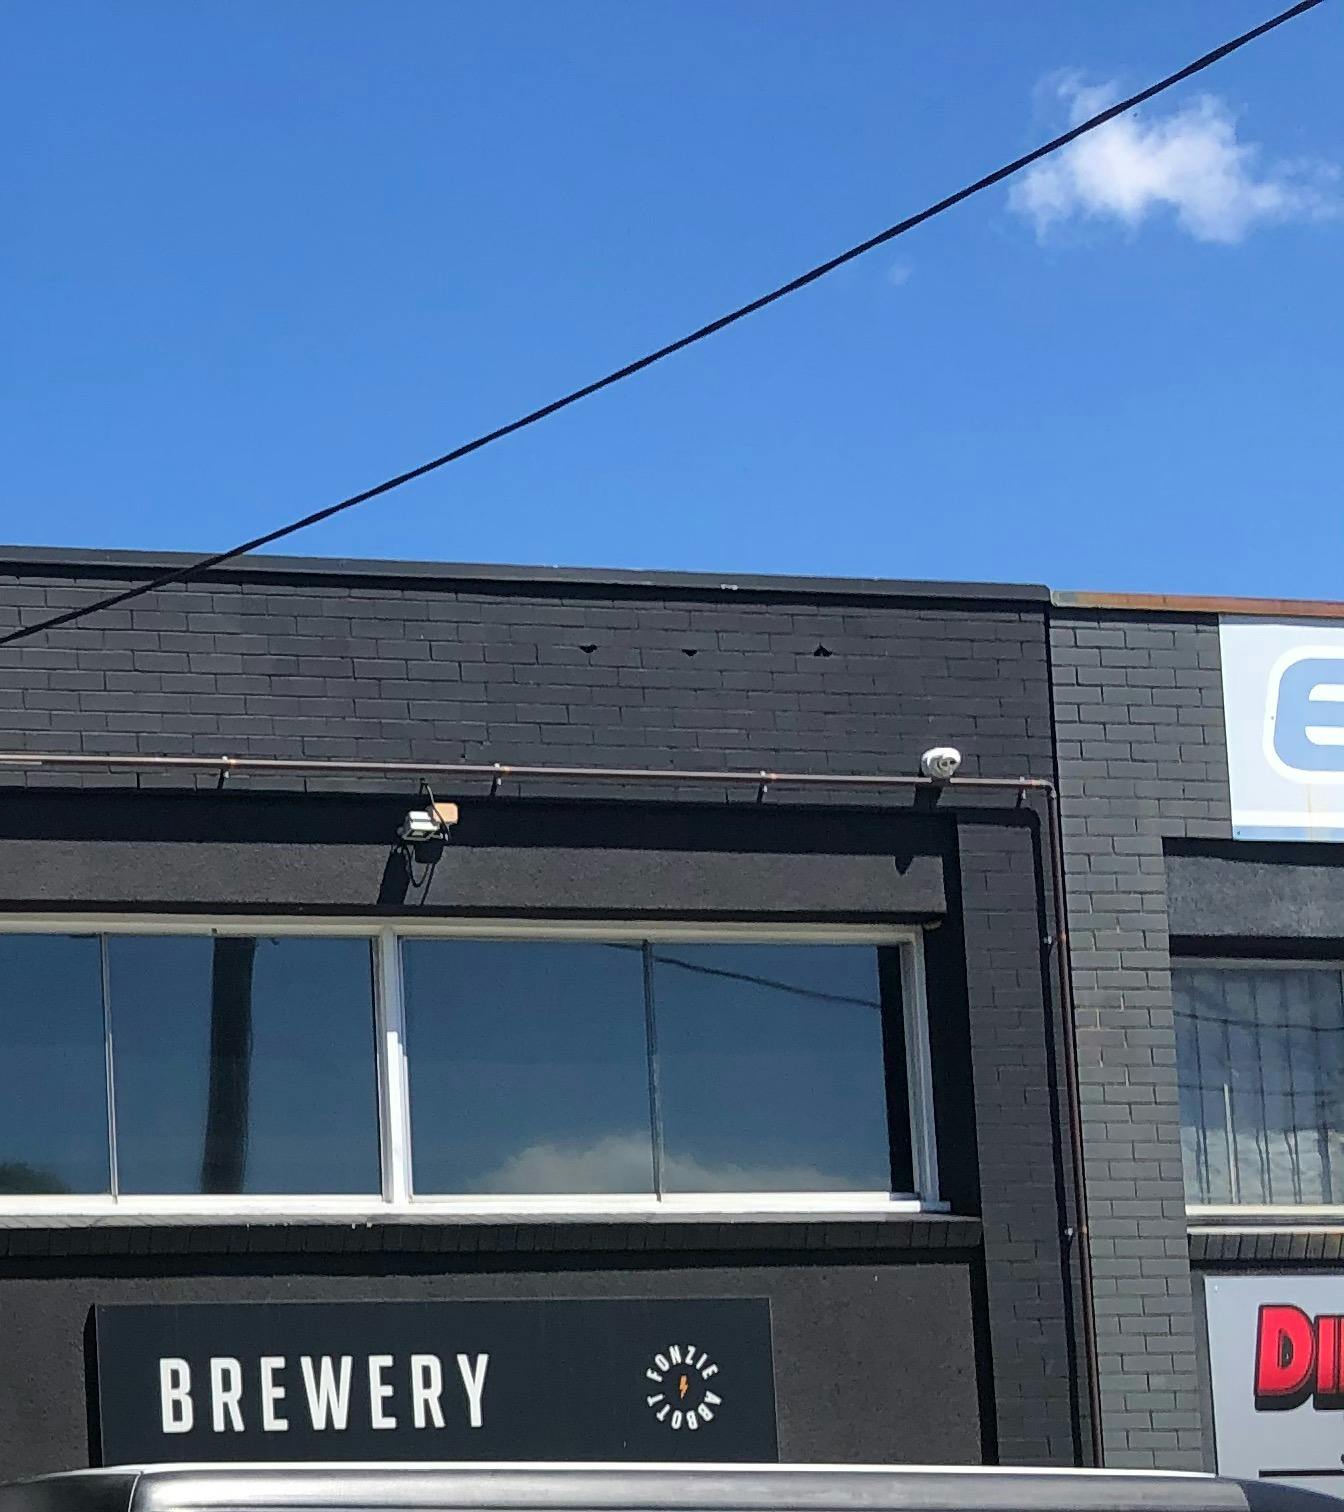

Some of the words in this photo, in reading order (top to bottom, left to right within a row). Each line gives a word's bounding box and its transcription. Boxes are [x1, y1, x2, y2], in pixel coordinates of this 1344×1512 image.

[645, 1344, 719, 1382] FONZIE
[159, 1353, 490, 1434] BREWERY
[646, 1390, 723, 1430] ABBOTT
